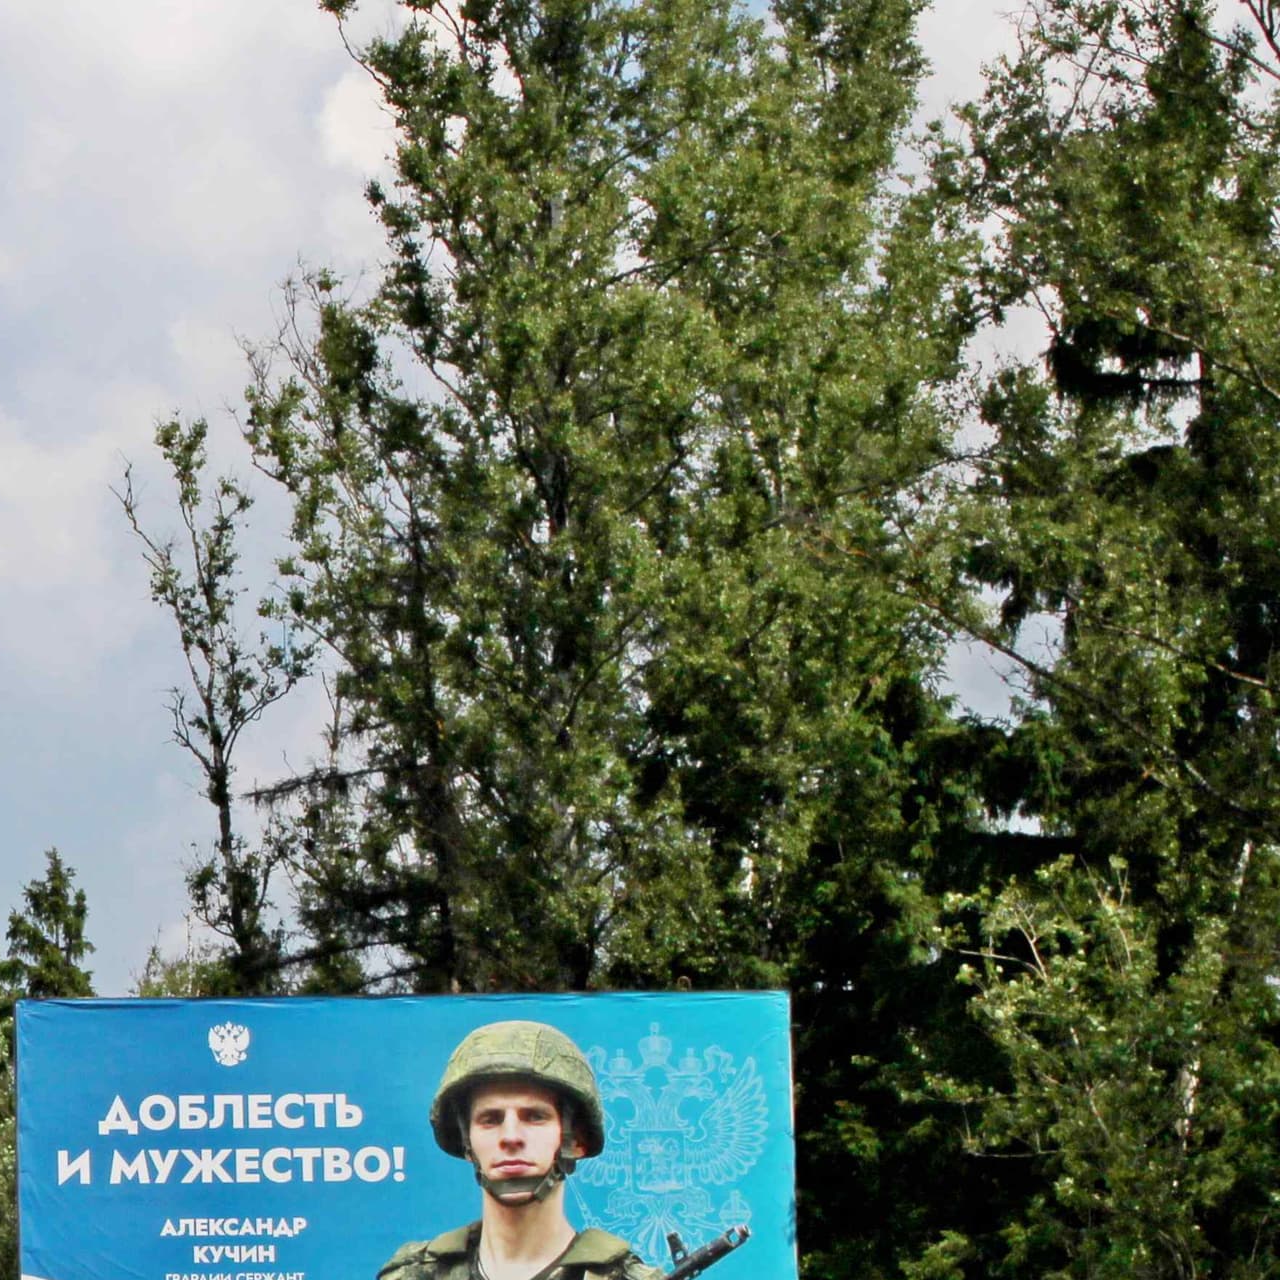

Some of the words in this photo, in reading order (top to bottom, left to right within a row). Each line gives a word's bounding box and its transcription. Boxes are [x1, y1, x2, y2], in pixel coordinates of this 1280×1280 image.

[97, 1092, 364, 1136] ДОБЛЕСТЬ
[56, 1148, 92, 1186] И
[108, 1145, 406, 1185] МУЖЕСТВО!
[159, 1216, 308, 1238] АЛЕКСАНДР
[192, 1244, 276, 1264] КУЧИН
